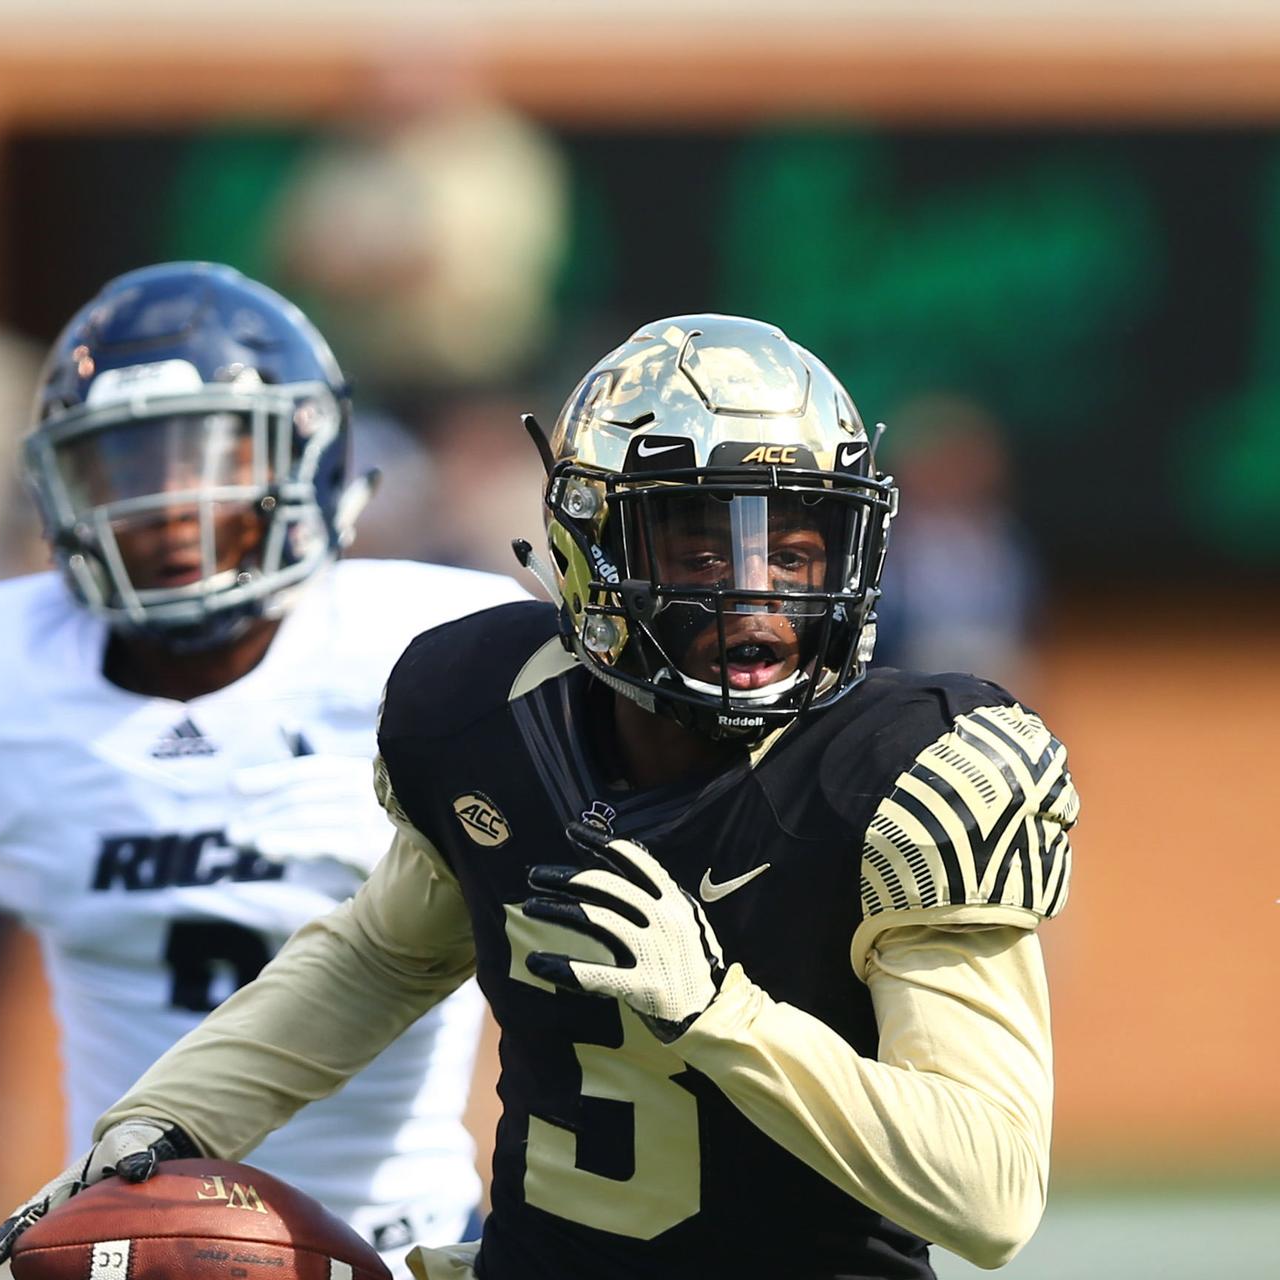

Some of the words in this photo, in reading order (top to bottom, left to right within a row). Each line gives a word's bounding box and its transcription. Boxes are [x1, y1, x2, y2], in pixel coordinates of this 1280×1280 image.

[741, 446, 798, 464] ACC
[718, 716, 763, 726] Riddell
[460, 804, 504, 836] ACC
[504, 904, 701, 1241] 3
[196, 1175, 268, 1215] WF
